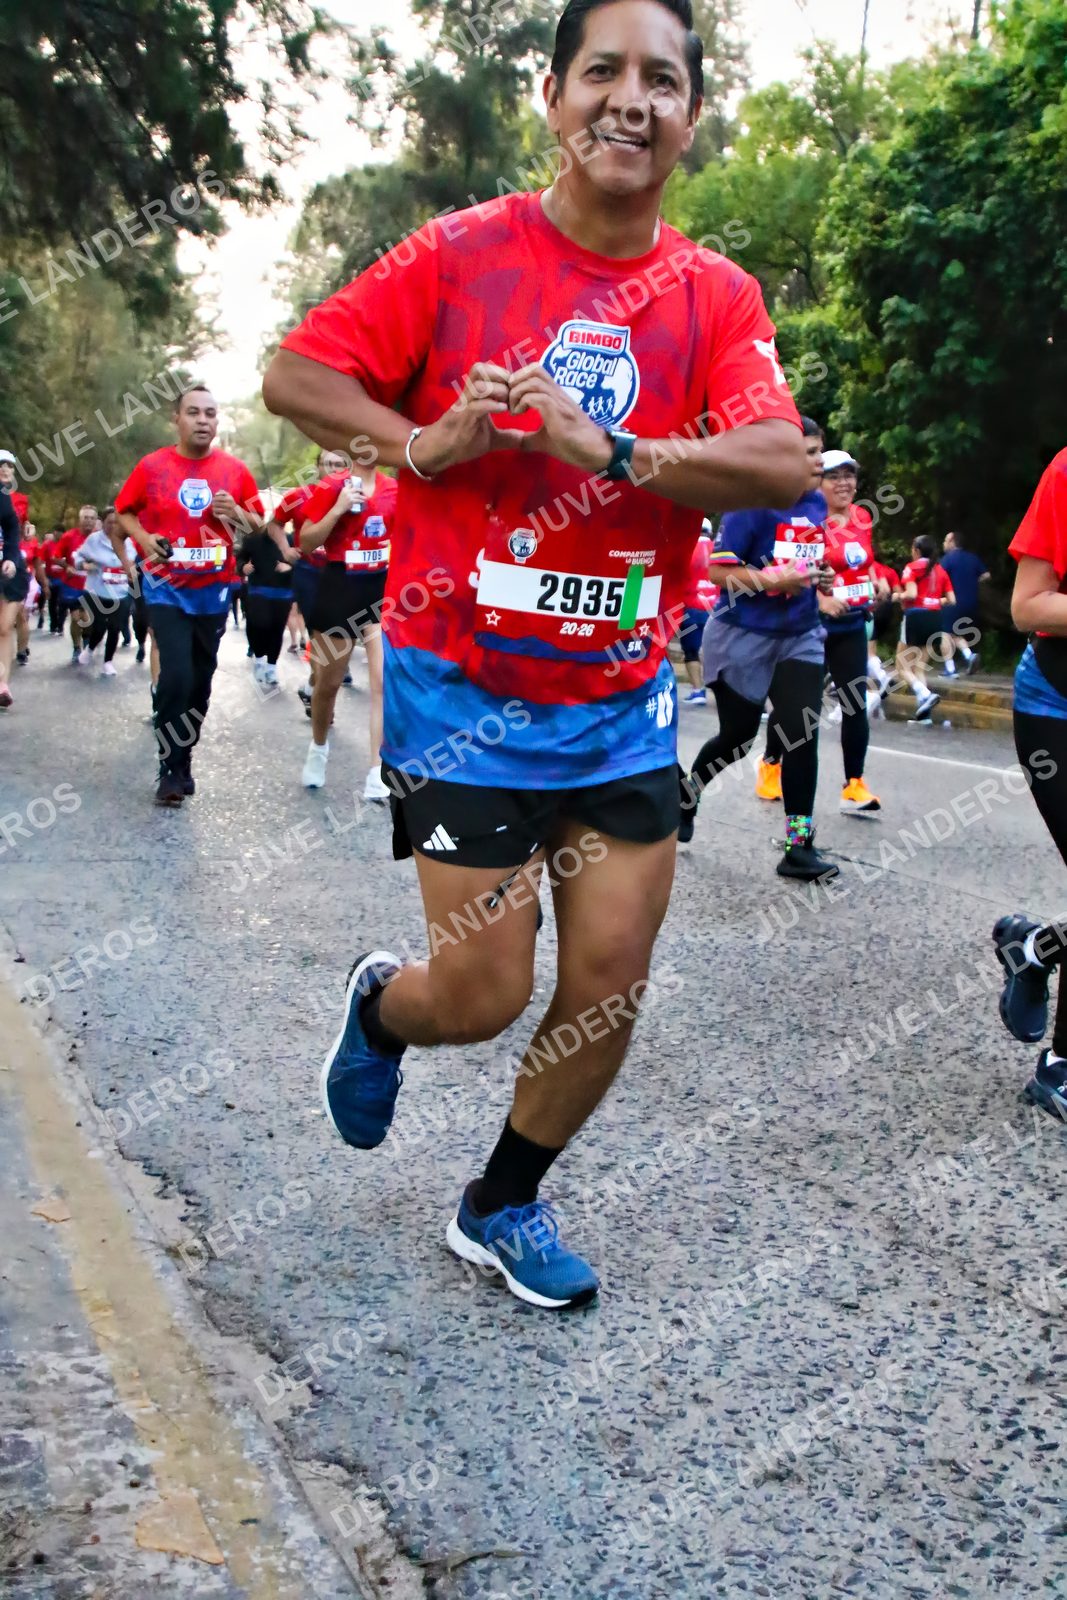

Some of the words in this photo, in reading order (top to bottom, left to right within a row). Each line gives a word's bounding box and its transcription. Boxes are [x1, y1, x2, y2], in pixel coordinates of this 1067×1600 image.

[569, 330, 622, 349] BIMBO
[566, 350, 619, 377] Global
[554, 366, 598, 389] Race
[536, 573, 625, 617] 2935
